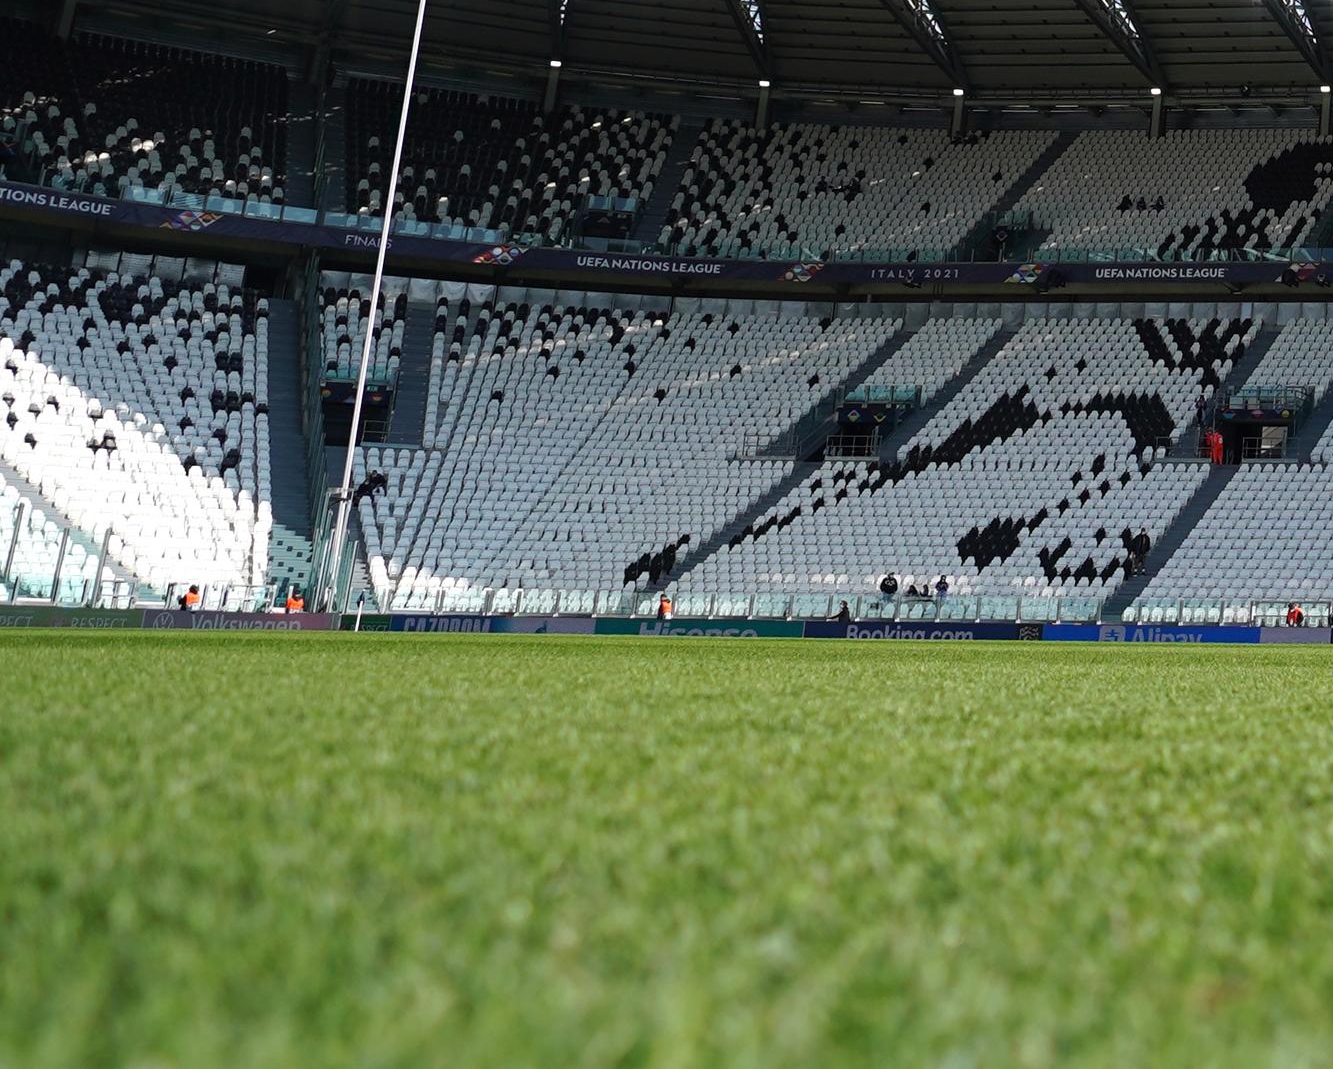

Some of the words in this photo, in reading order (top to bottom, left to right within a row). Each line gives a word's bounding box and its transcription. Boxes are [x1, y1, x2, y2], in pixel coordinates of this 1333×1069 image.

[48, 195, 112, 216] LEAGUE
[576, 256, 610, 268] UEFA
[611, 259, 670, 272] NATIONS
[671, 262, 721, 274] LEAGUE
[871, 269, 915, 279] ITALY
[924, 269, 959, 279] 2021
[1095, 268, 1125, 278] UEFA
[1126, 268, 1178, 278] NATIONS
[1179, 267, 1225, 278] LEAGUE
